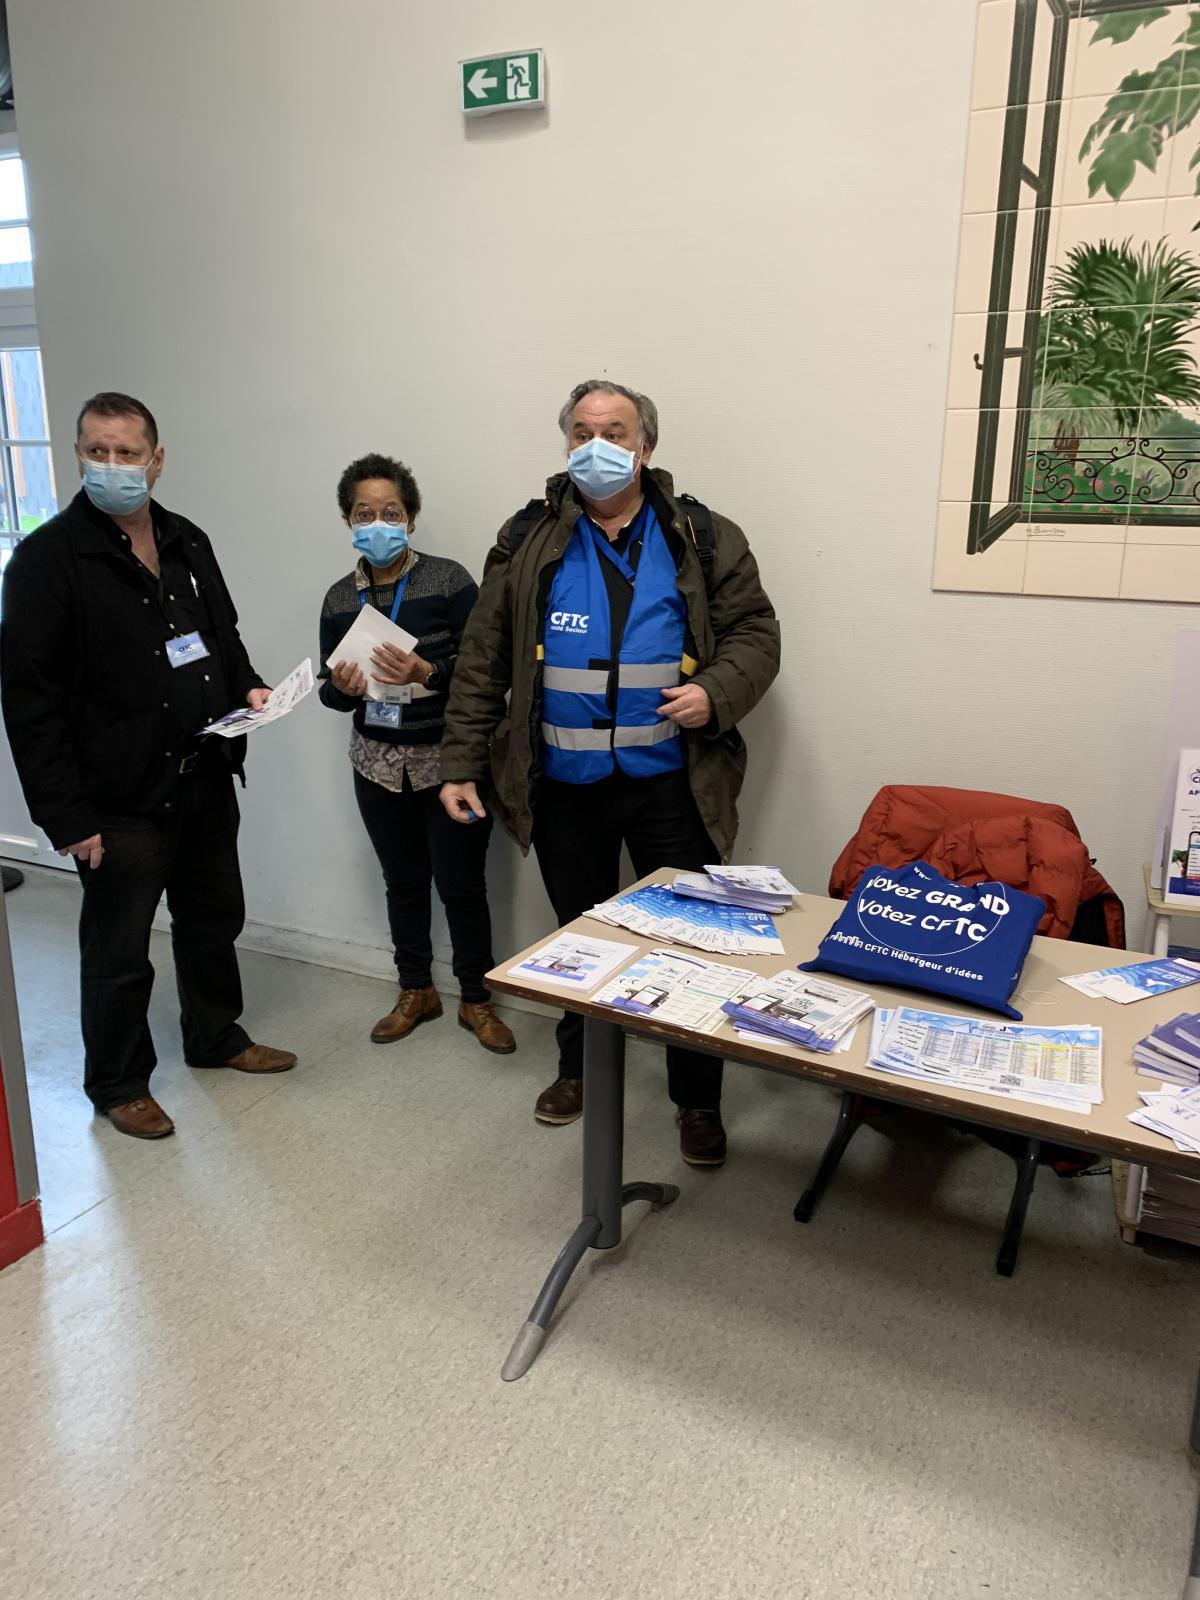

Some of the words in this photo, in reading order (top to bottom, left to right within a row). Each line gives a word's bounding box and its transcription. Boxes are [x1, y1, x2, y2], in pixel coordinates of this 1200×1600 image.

[550, 611, 590, 628] CFTC
[925, 890, 1010, 916] GRAND
[858, 898, 917, 926] Votez
[920, 915, 988, 942] CFTC
[864, 943, 889, 956] CFTC
[890, 949, 943, 971] Hébergeur
[944, 965, 984, 981] d'idées
